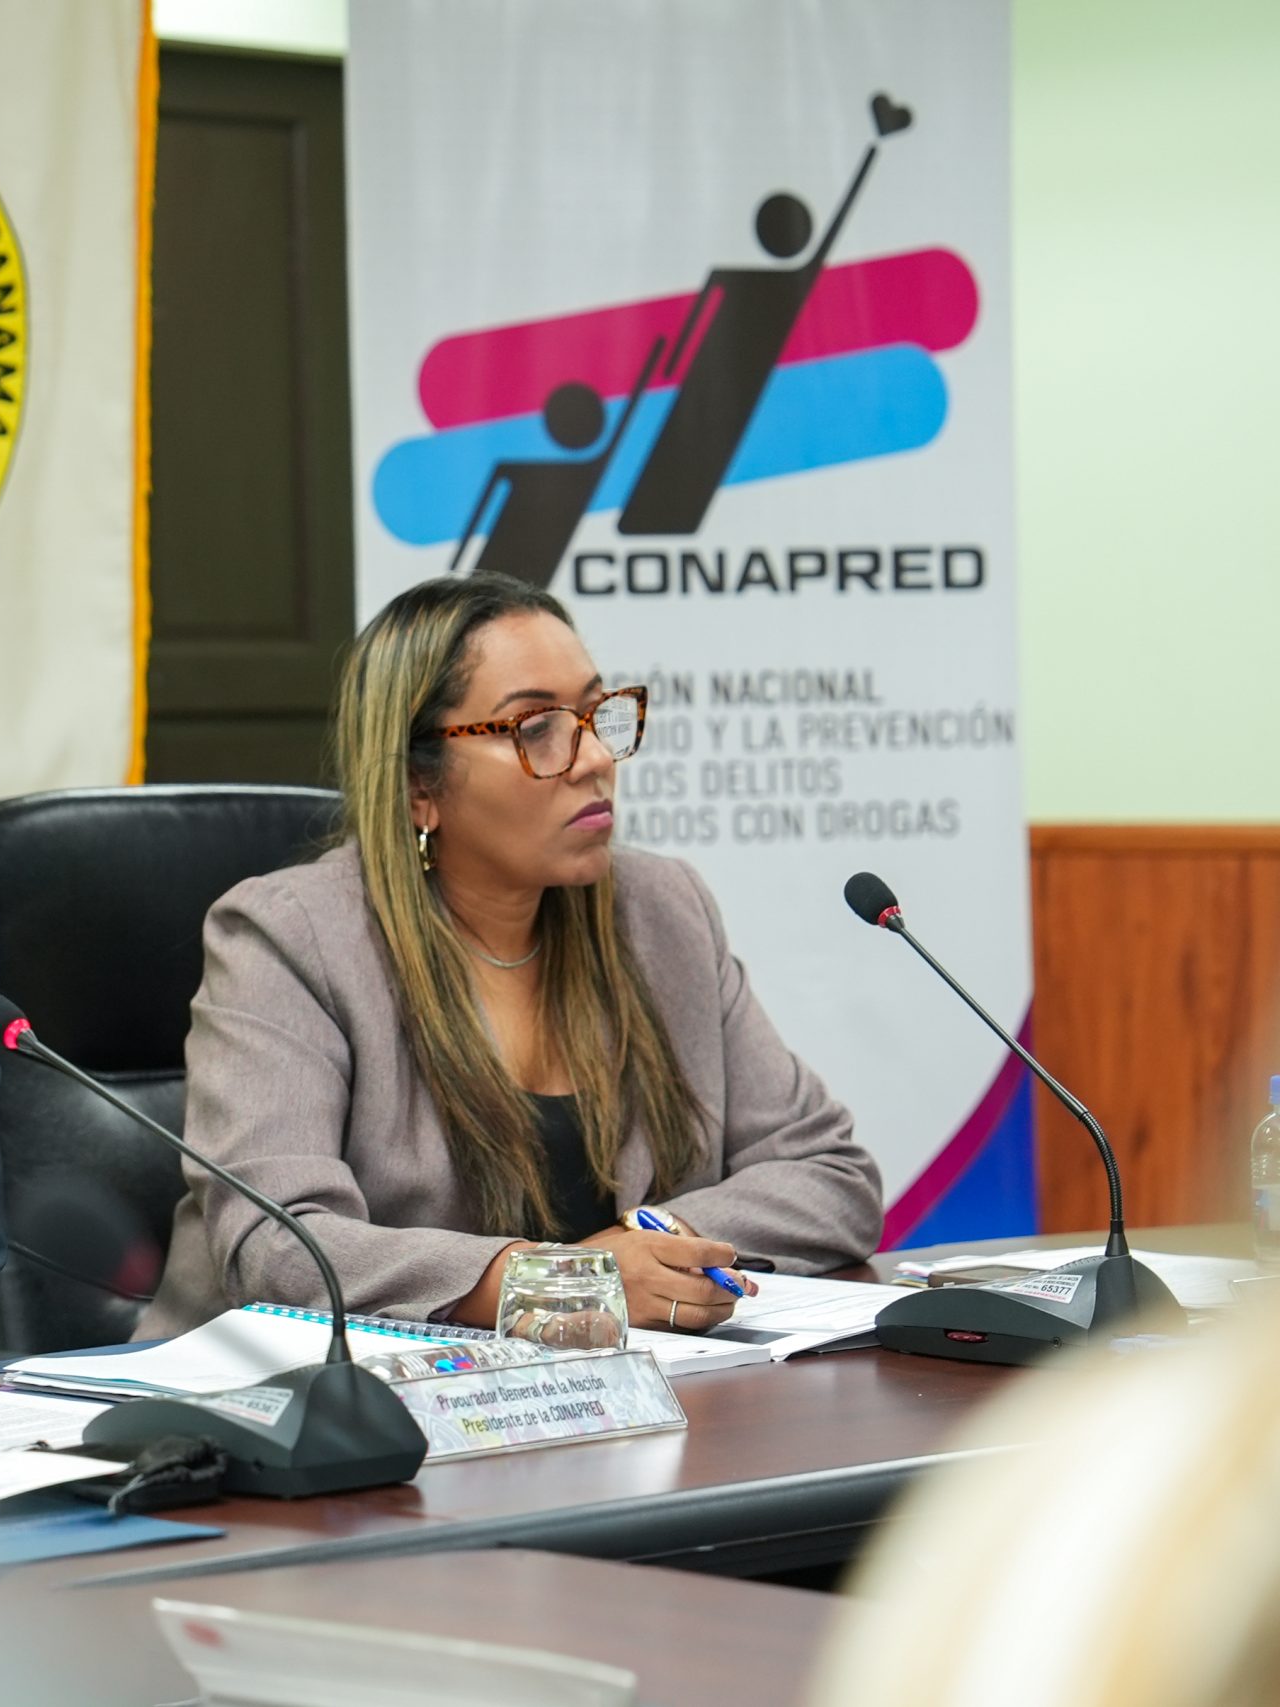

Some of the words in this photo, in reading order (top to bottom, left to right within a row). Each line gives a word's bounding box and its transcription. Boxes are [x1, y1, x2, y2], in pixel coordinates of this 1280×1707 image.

[574, 547, 985, 596] CONAPRED
[710, 667, 883, 707] NACIONAL
[705, 715, 728, 751] Y
[742, 714, 786, 754] LA
[798, 700, 1015, 753] PREVENCIÓN
[621, 760, 687, 802] LOS
[700, 757, 843, 800] DELITOS
[732, 803, 804, 845] CON
[817, 798, 960, 843] DROGAS
[1041, 1284, 1071, 1295] 65377
[437, 1389, 498, 1410] Procurador
[498, 1382, 541, 1401] General
[542, 1381, 555, 1396] de
[556, 1379, 568, 1394] la
[569, 1375, 606, 1392] Nación
[462, 1414, 522, 1435] Presidente
[524, 1410, 537, 1426] de
[539, 1408, 551, 1423] la
[551, 1400, 605, 1422] CONAPRED
